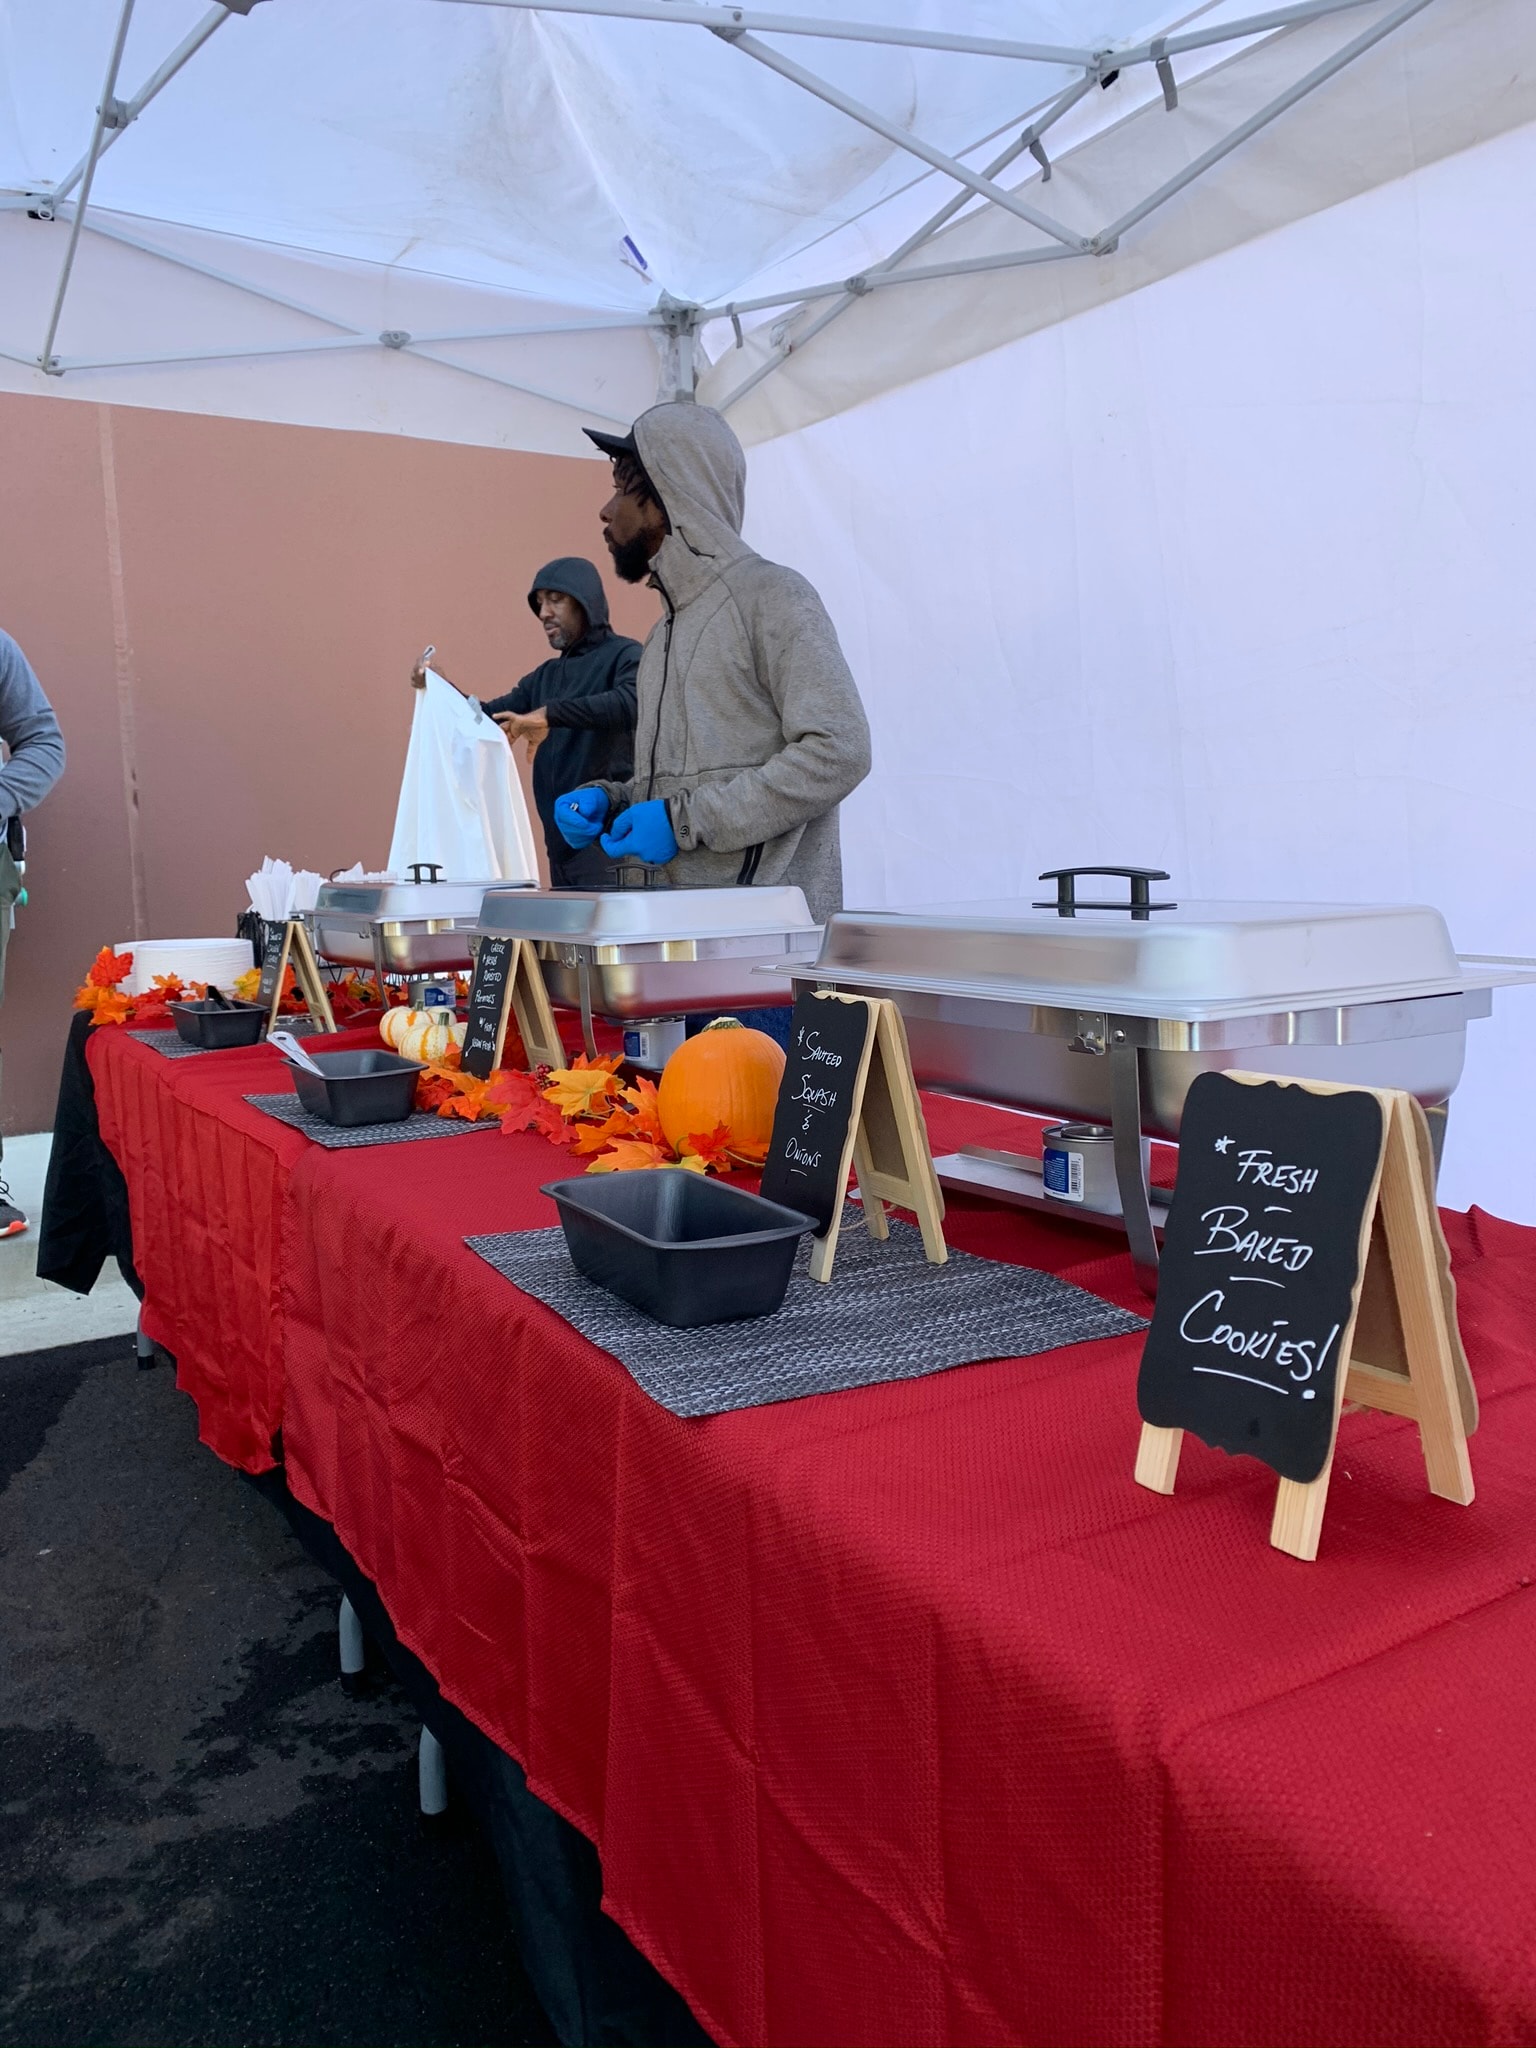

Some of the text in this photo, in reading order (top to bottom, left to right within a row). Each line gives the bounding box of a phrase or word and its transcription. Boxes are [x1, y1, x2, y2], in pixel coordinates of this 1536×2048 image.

[801, 1031, 843, 1068] SAUTEED
[791, 1073, 838, 1108] SQUASH
[785, 1137, 822, 1168] ONIONS
[1236, 1150, 1319, 1195] FRESH
[1193, 1204, 1313, 1273] BAKED
[1179, 1289, 1340, 1399] COOKIES!
